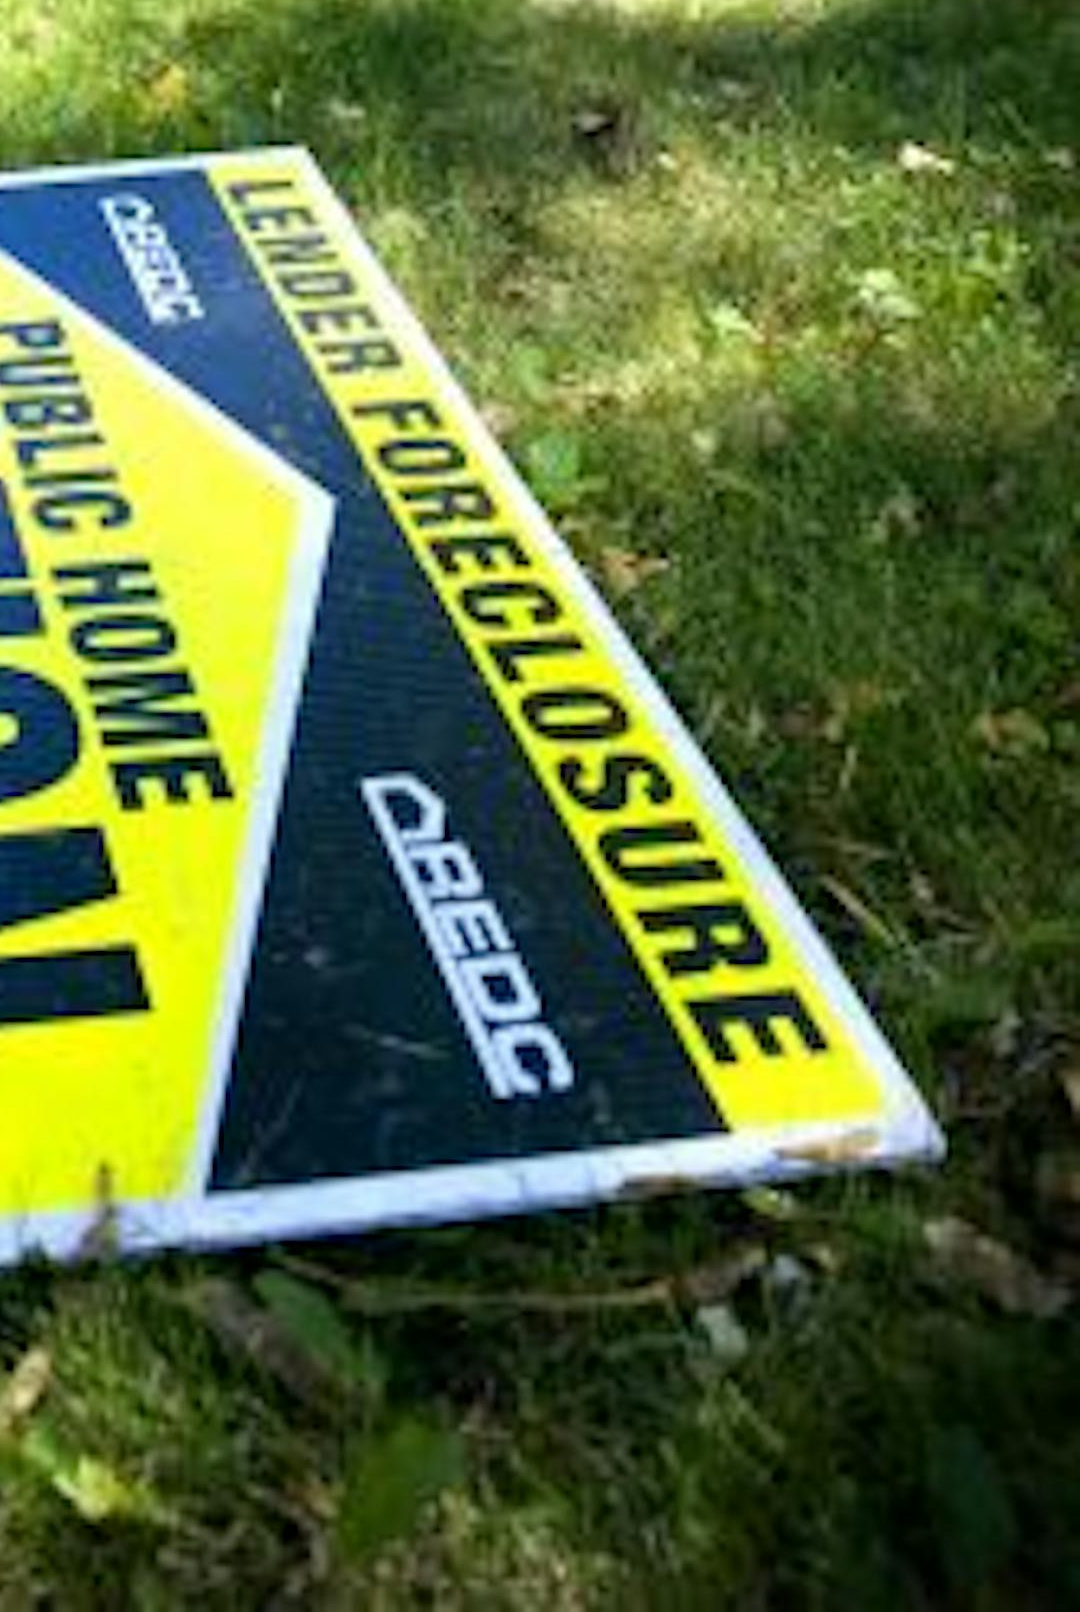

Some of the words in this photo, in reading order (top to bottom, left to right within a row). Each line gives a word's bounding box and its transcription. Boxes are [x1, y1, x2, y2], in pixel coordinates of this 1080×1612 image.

[52, 561, 235, 812] HOME
[227, 180, 403, 375] LENDER
[353, 399, 827, 1067] FORECLOSURE
[402, 834, 575, 1100] REDC
